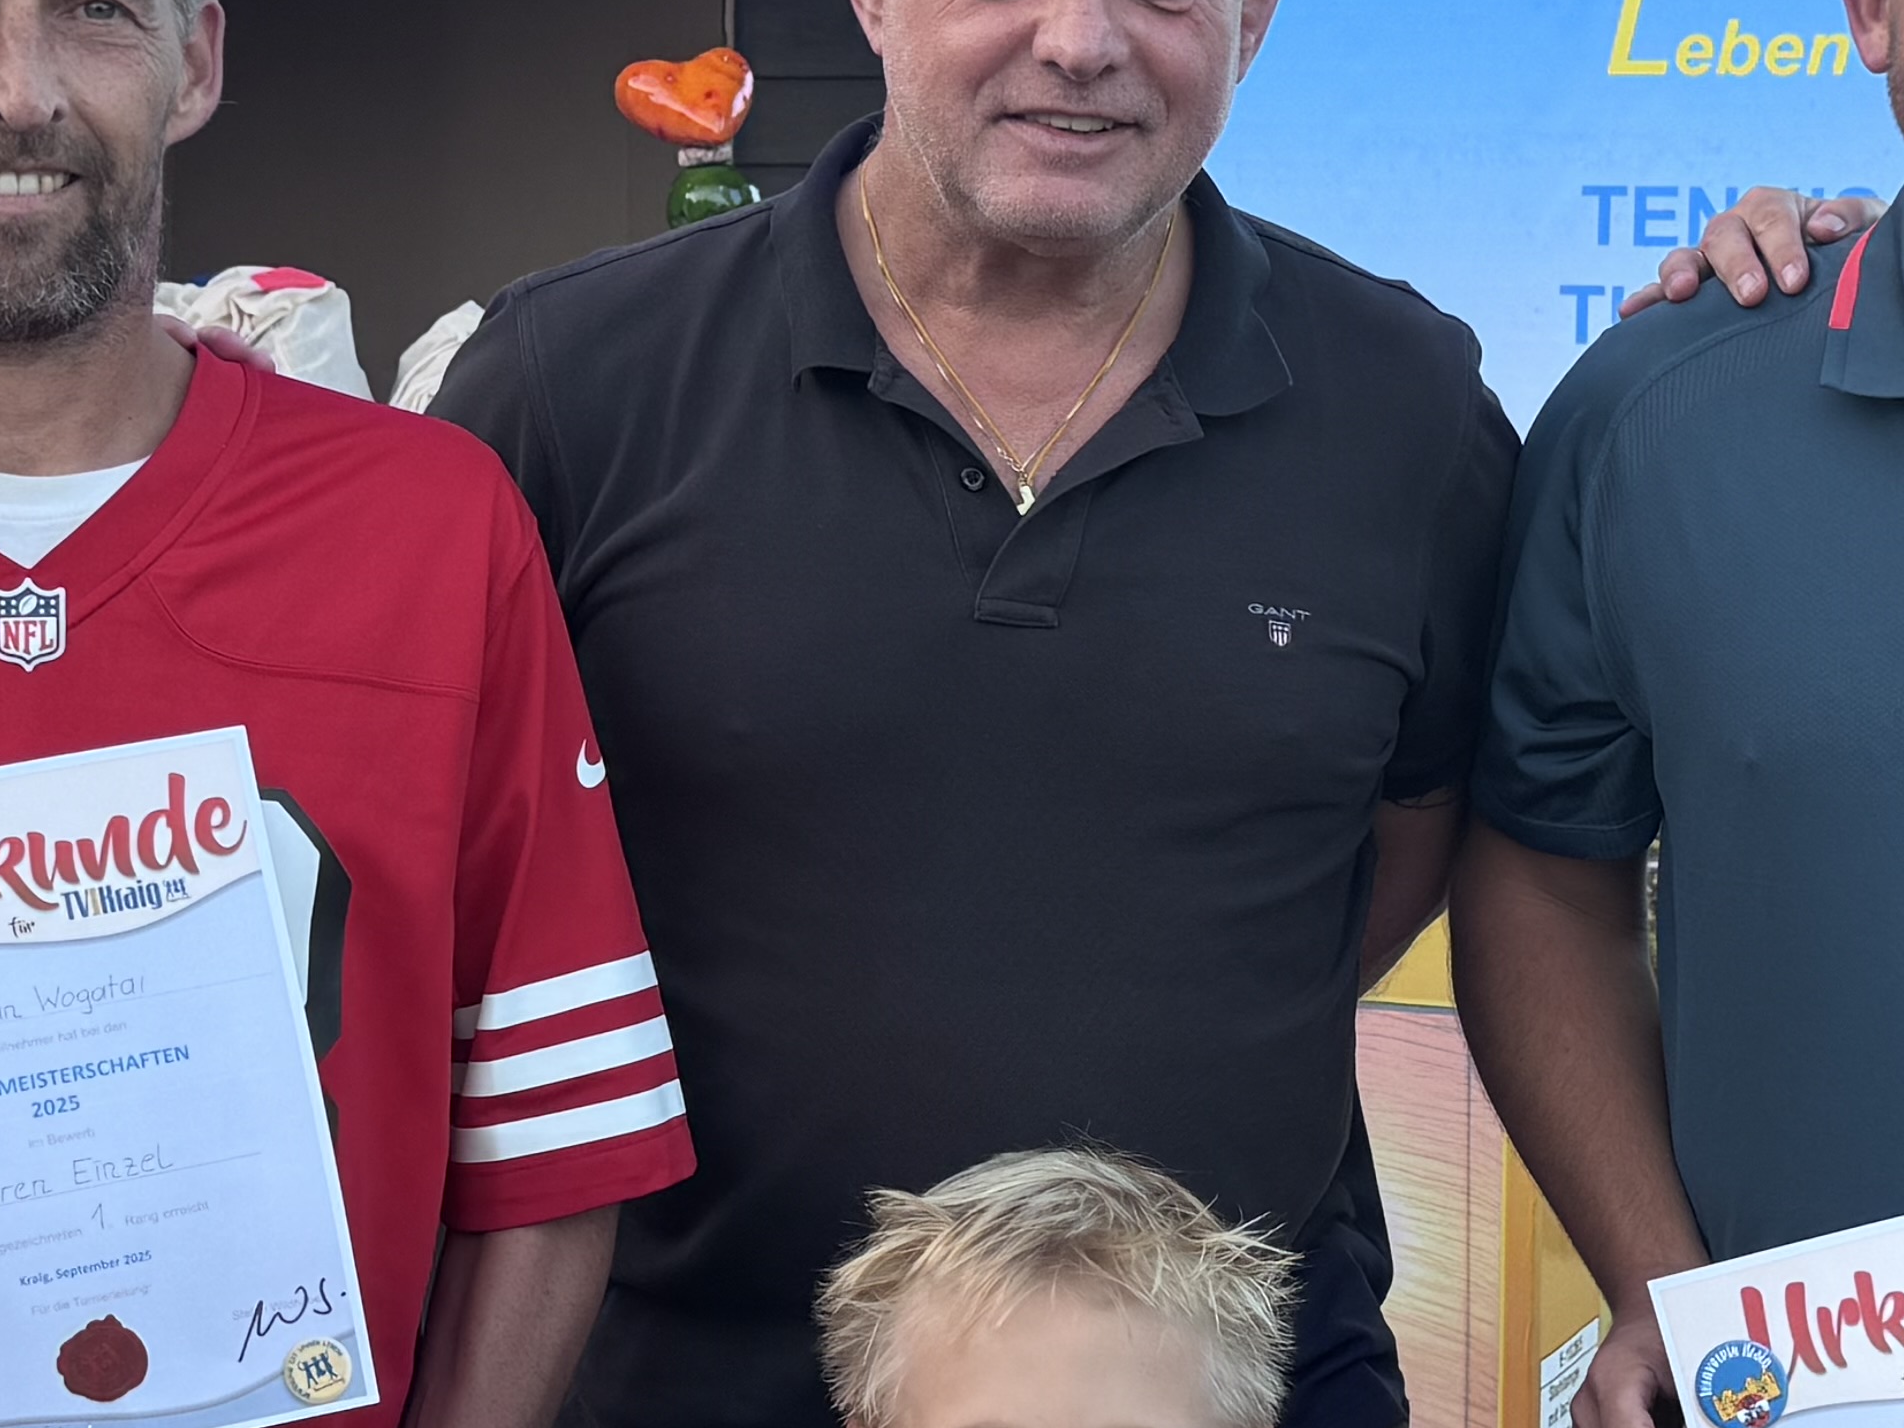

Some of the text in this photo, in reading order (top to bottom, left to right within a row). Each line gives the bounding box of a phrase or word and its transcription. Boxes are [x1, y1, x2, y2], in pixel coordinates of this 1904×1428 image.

[1248, 603, 1312, 622] GANT
[2, 620, 54, 655] NFL
[9, 915, 37, 939] für
[31, 1094, 81, 1118] 2025
[71, 1143, 174, 1186] Einzel
[55, 1257, 121, 1281] September
[124, 1249, 153, 1266] 2025
